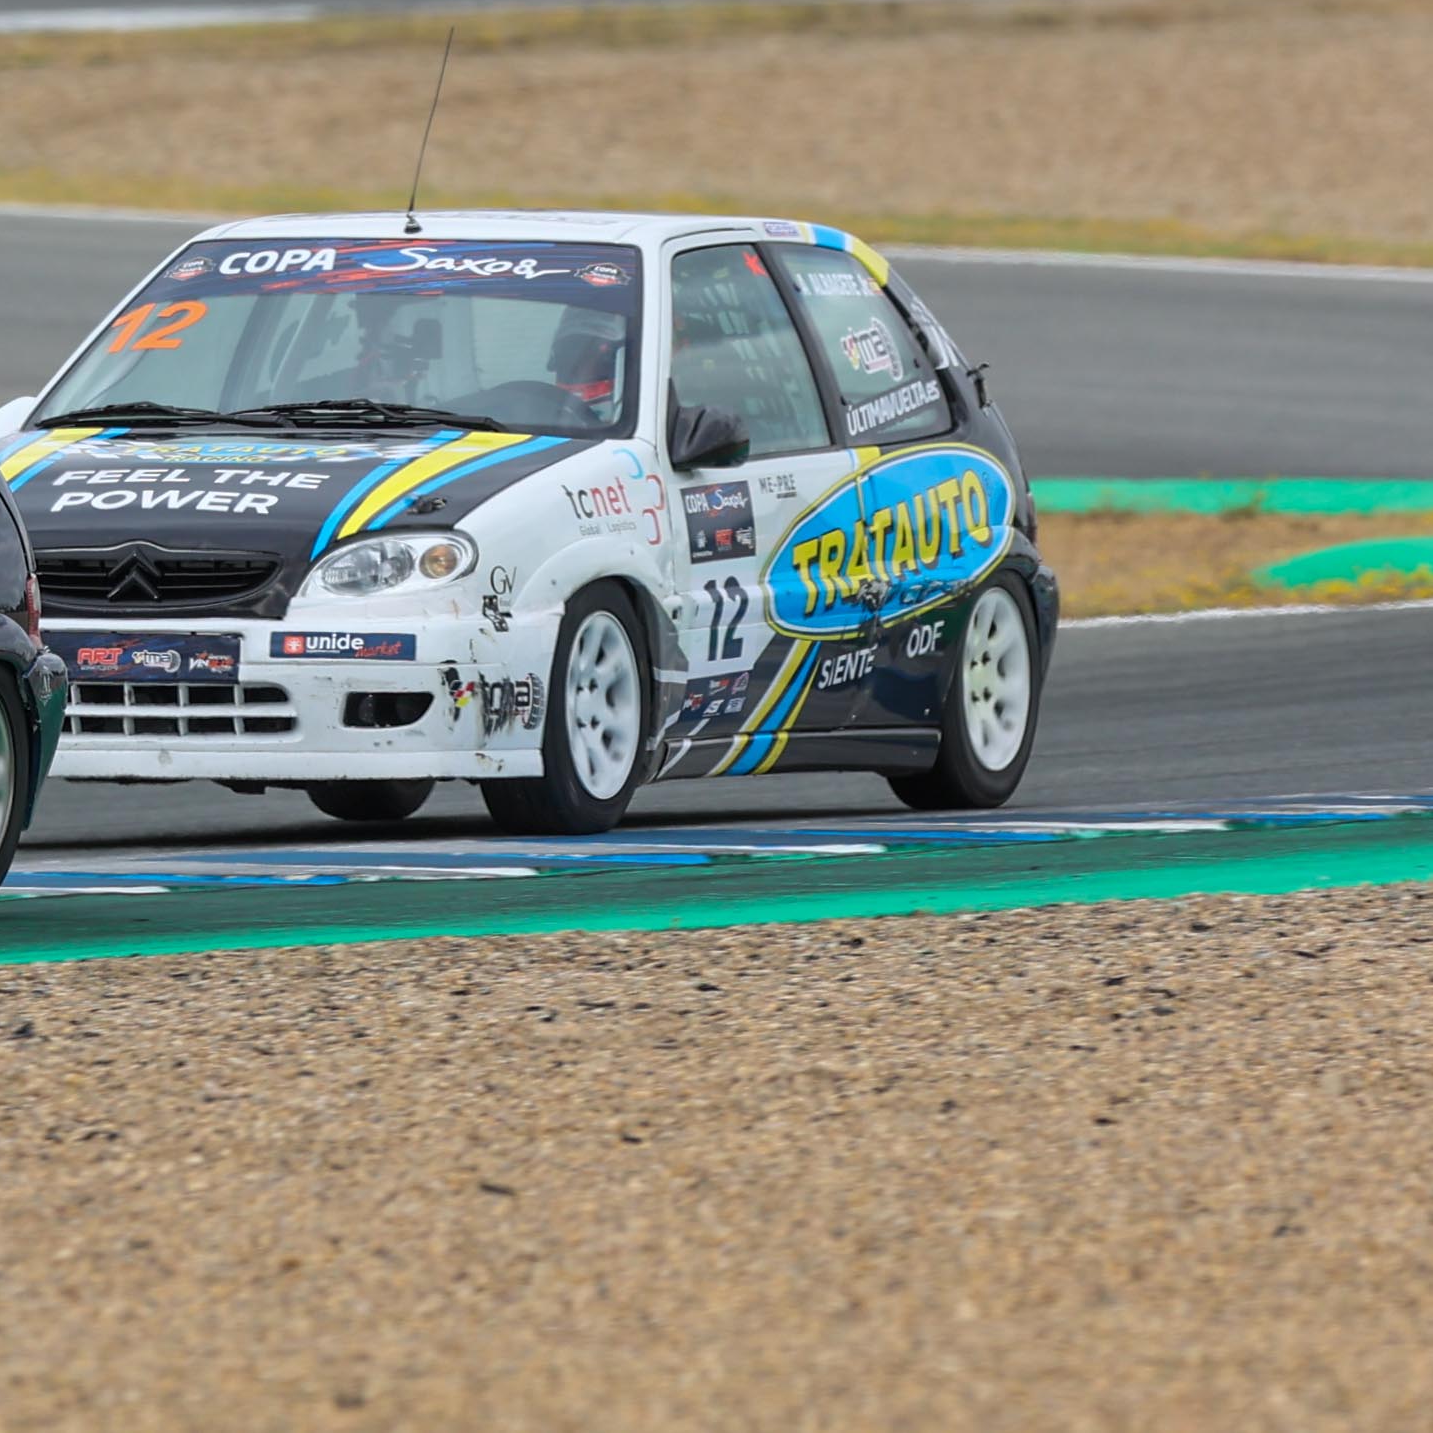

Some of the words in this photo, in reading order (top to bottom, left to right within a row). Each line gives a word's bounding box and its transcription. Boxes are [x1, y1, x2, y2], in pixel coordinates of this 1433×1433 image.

[219, 248, 338, 275] COPA
[106, 299, 209, 356] 12
[52, 468, 193, 487] FEEL
[204, 468, 332, 490] THE
[50, 488, 281, 515] POWER
[561, 476, 632, 521] tcnet
[792, 468, 992, 615] TRATAUTO
[703, 575, 750, 663] 12
[305, 633, 365, 651] unide
[76, 647, 124, 666] ART
